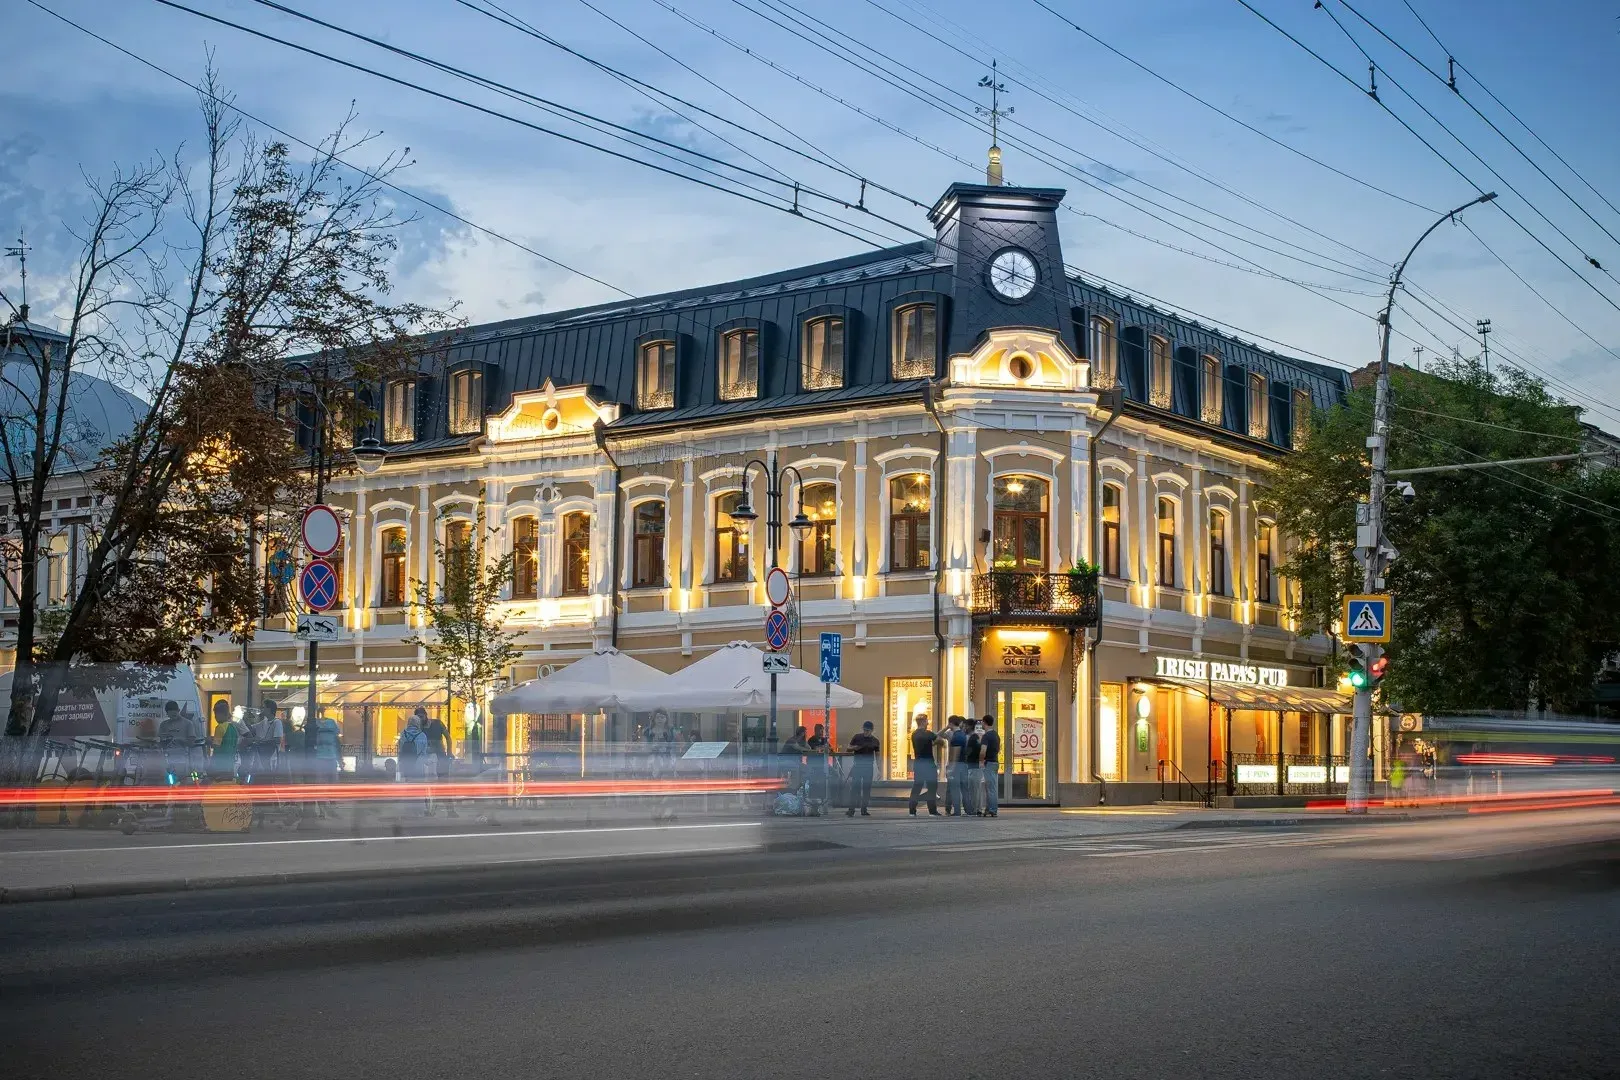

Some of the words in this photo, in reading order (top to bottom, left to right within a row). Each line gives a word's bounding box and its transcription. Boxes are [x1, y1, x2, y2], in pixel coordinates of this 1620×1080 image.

[1003, 658, 1040, 666] OUTLET
[1156, 656, 1208, 680] IRISH
[1210, 662, 1257, 684] PAPA'S
[1258, 667, 1288, 687] PUB
